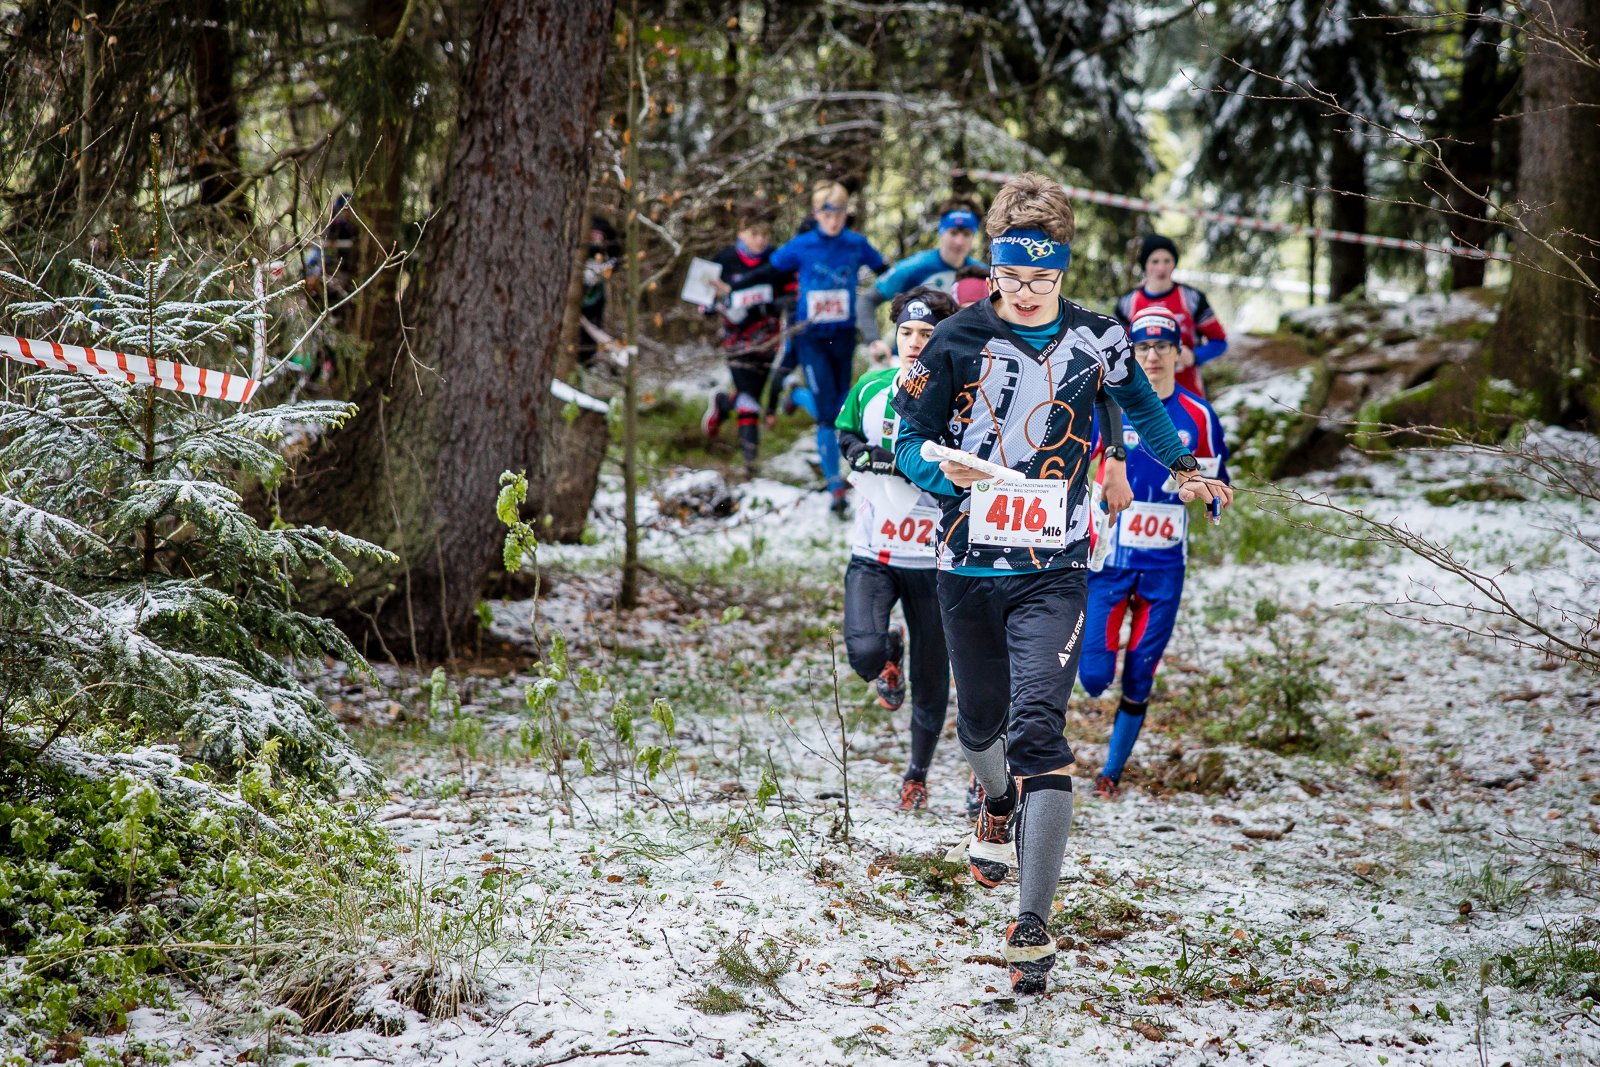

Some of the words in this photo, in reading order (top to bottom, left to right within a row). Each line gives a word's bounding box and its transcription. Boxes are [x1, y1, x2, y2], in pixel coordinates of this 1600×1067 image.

[985, 494, 1047, 532] 416
[1128, 513, 1174, 539] 406
[880, 517, 934, 544] 402
[1042, 526, 1062, 537] M16
[1064, 632, 1078, 652] TRUE
[1074, 610, 1085, 635] STORY
